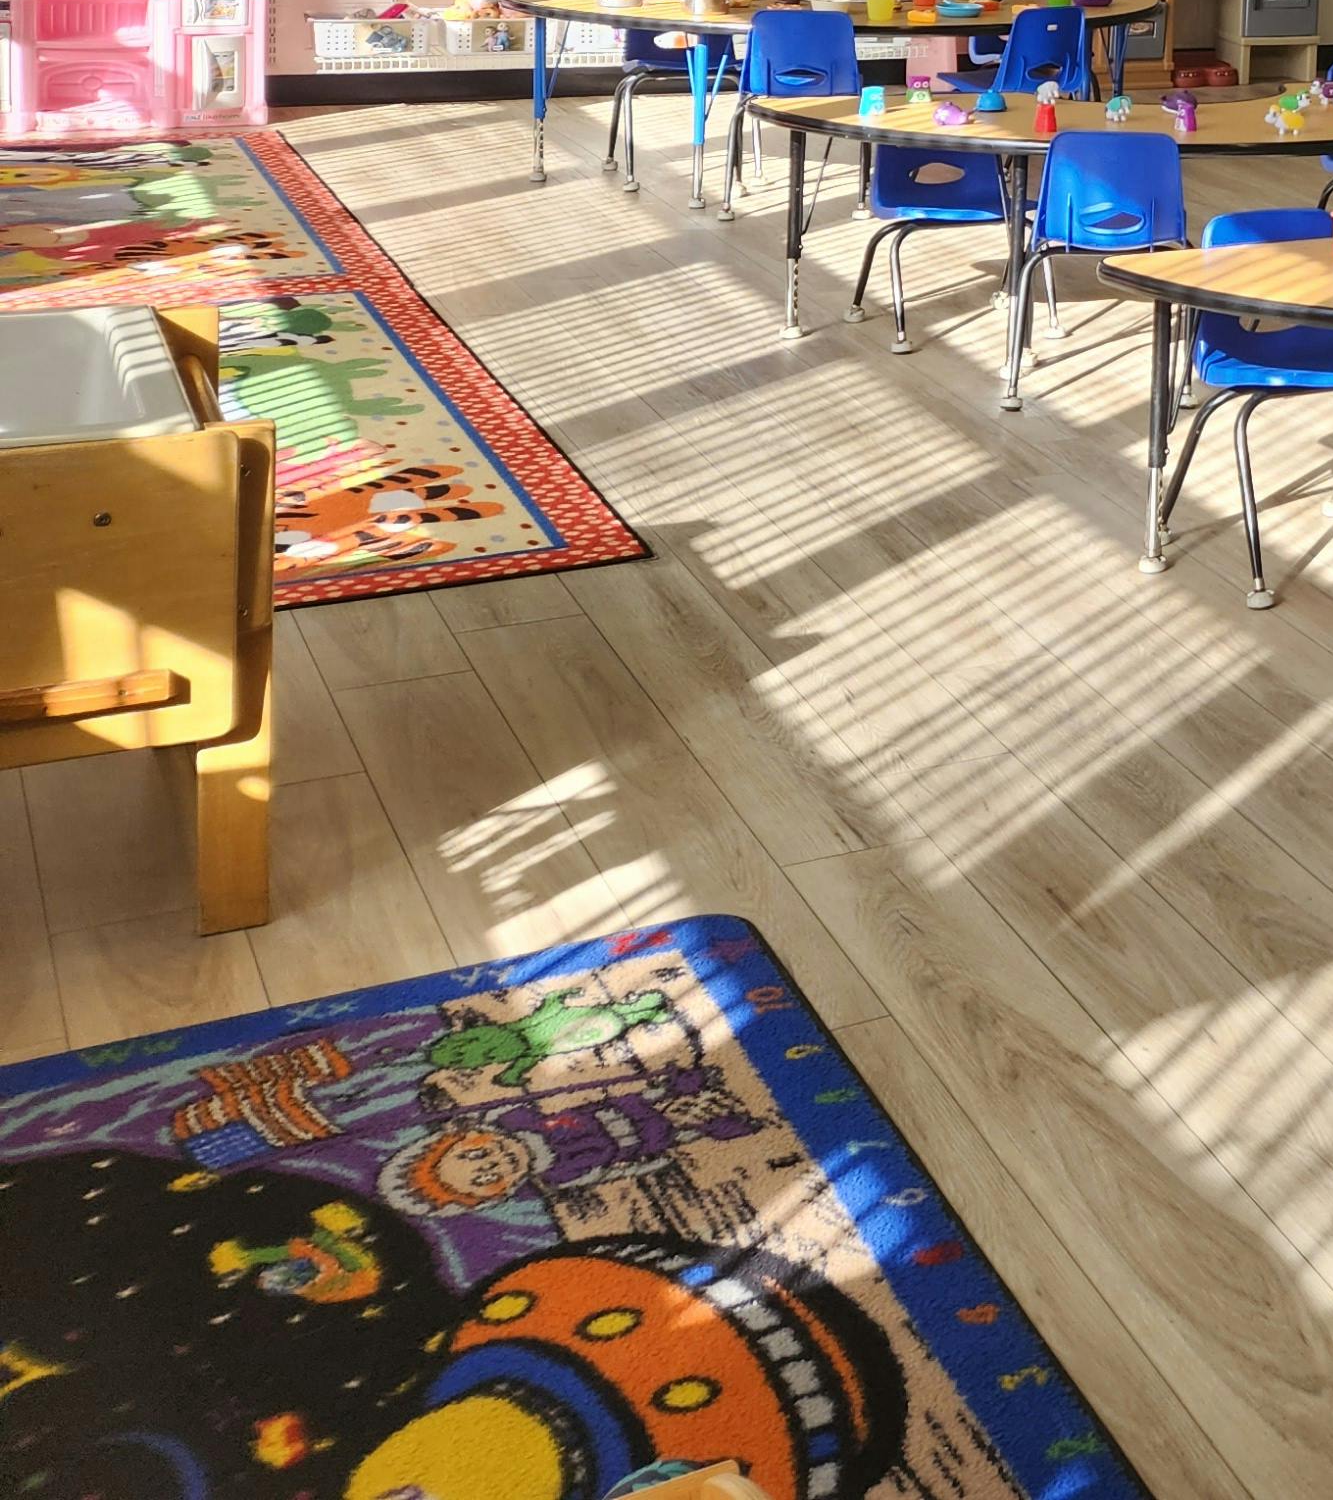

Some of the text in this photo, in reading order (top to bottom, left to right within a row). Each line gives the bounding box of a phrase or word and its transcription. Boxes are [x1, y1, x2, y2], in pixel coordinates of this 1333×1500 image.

[747, 986, 795, 1013] 10
[286, 1001, 354, 1026] Xx
[79, 1039, 182, 1067] Ww
